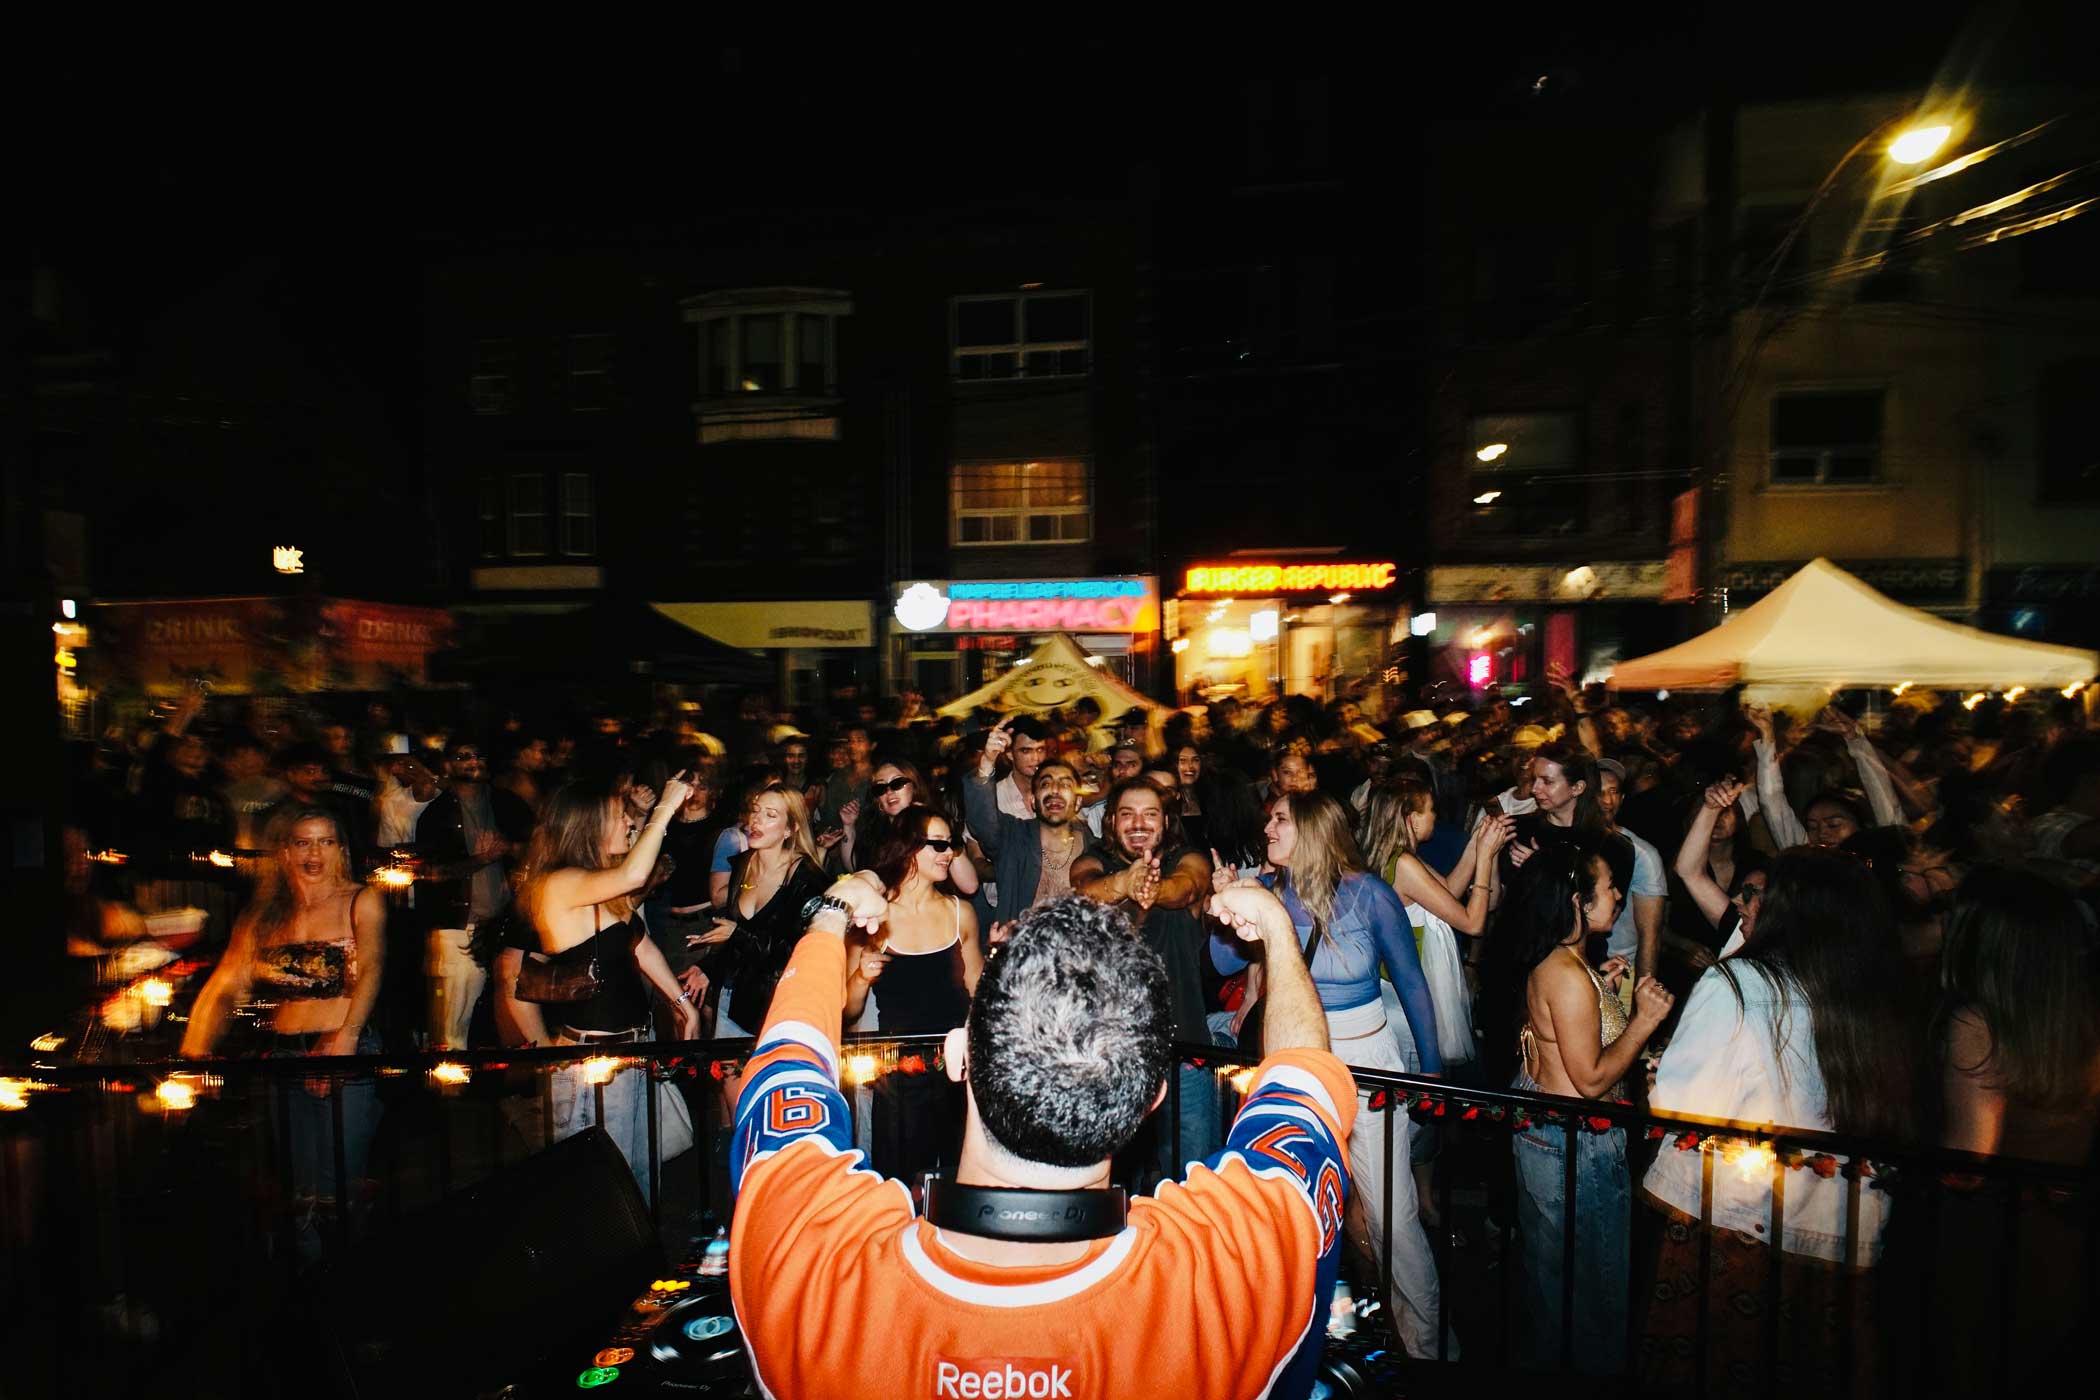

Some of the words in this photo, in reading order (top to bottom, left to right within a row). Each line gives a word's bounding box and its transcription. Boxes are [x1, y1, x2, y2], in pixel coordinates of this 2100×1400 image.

[1187, 567, 1281, 592] BURGER
[1281, 564, 1396, 590] REPUBLIC
[947, 597, 1141, 629] PHARMACY
[144, 615, 241, 641] DRINK
[359, 619, 433, 643] DRINK
[936, 1361, 1073, 1400] Reebok
